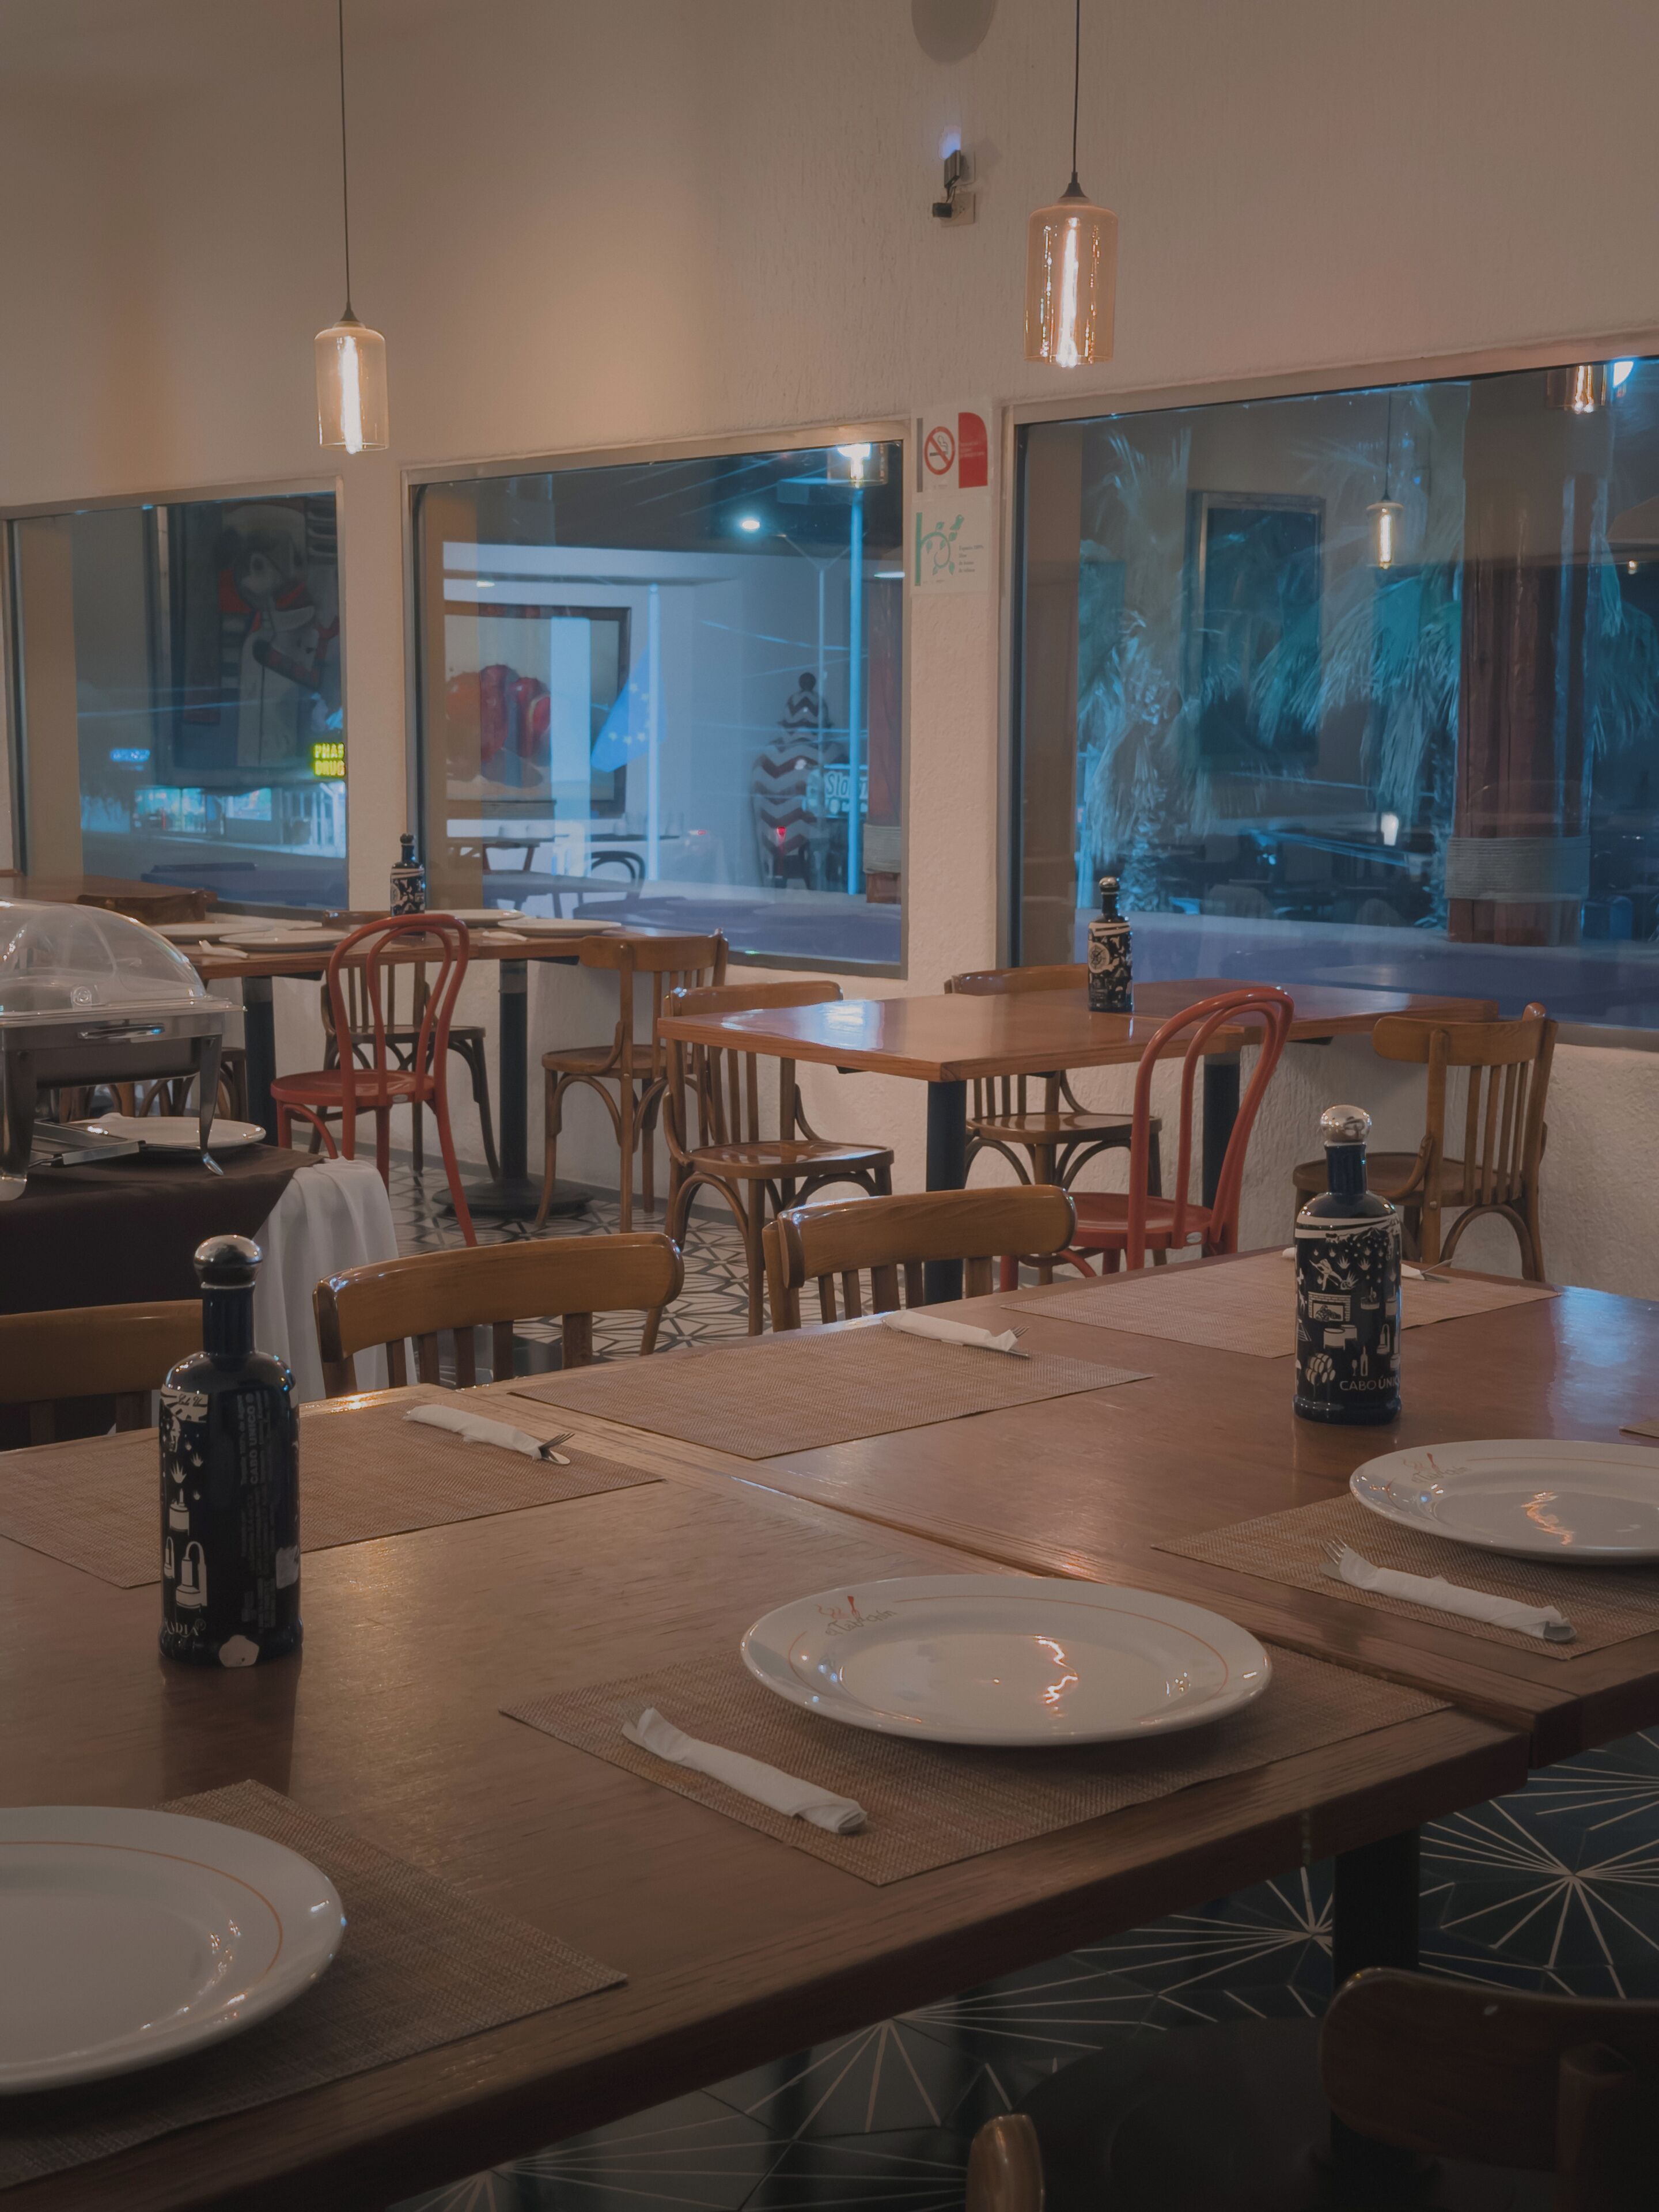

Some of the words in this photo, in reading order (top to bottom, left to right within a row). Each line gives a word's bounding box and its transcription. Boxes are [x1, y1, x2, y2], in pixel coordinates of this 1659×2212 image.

[1339, 1380, 1377, 1391] CABO
[247, 1405, 257, 1446] UNICO
[249, 1449, 259, 1484] CABO
